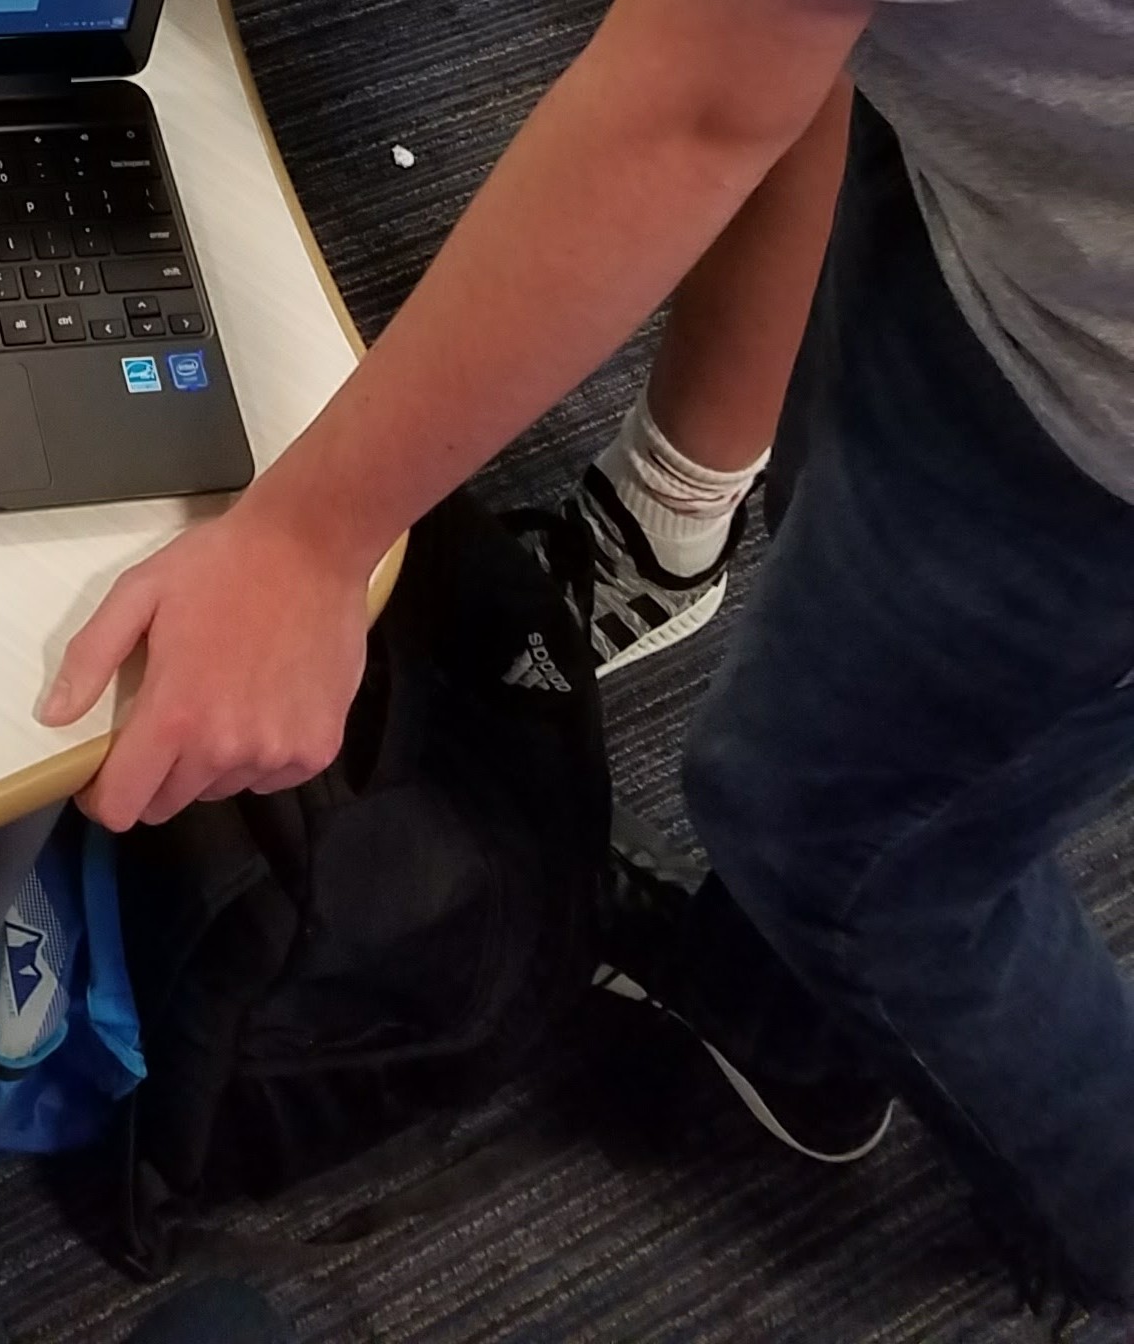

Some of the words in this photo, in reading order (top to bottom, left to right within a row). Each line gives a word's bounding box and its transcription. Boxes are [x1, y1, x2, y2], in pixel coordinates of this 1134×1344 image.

[15, 320, 27, 329] alt
[58, 316, 73, 325] ctrl
[528, 632, 572, 692] adidas
